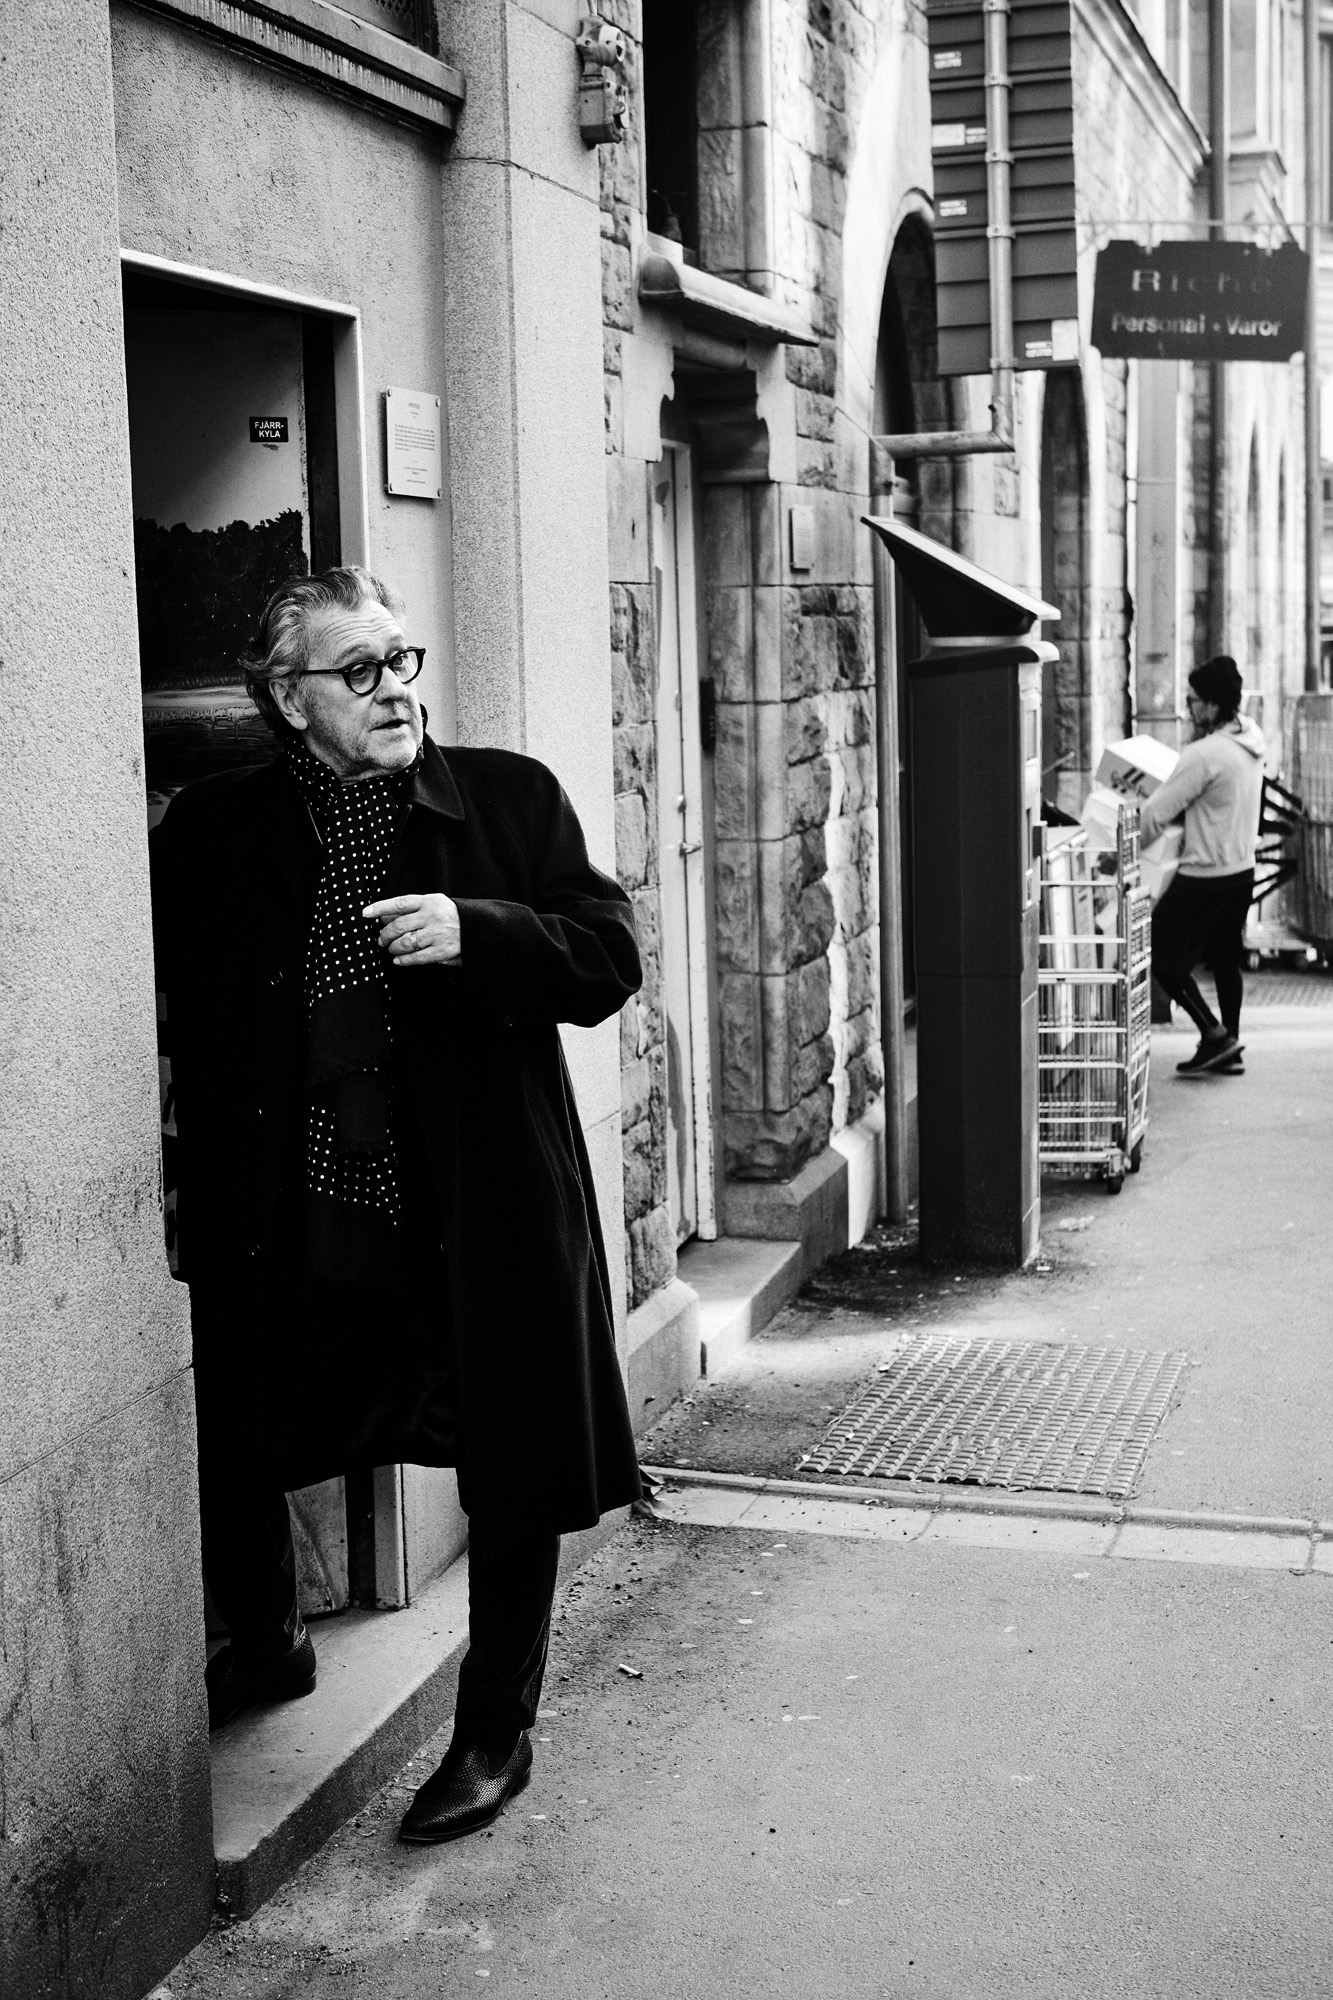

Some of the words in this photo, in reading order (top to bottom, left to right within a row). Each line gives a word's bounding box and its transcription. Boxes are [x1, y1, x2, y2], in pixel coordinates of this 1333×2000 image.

[1111, 312, 1206, 334] Personal
[1227, 314, 1282, 337] Varor
[254, 420, 284, 429] FJÄRR-
[258, 430, 281, 438] KYLA
